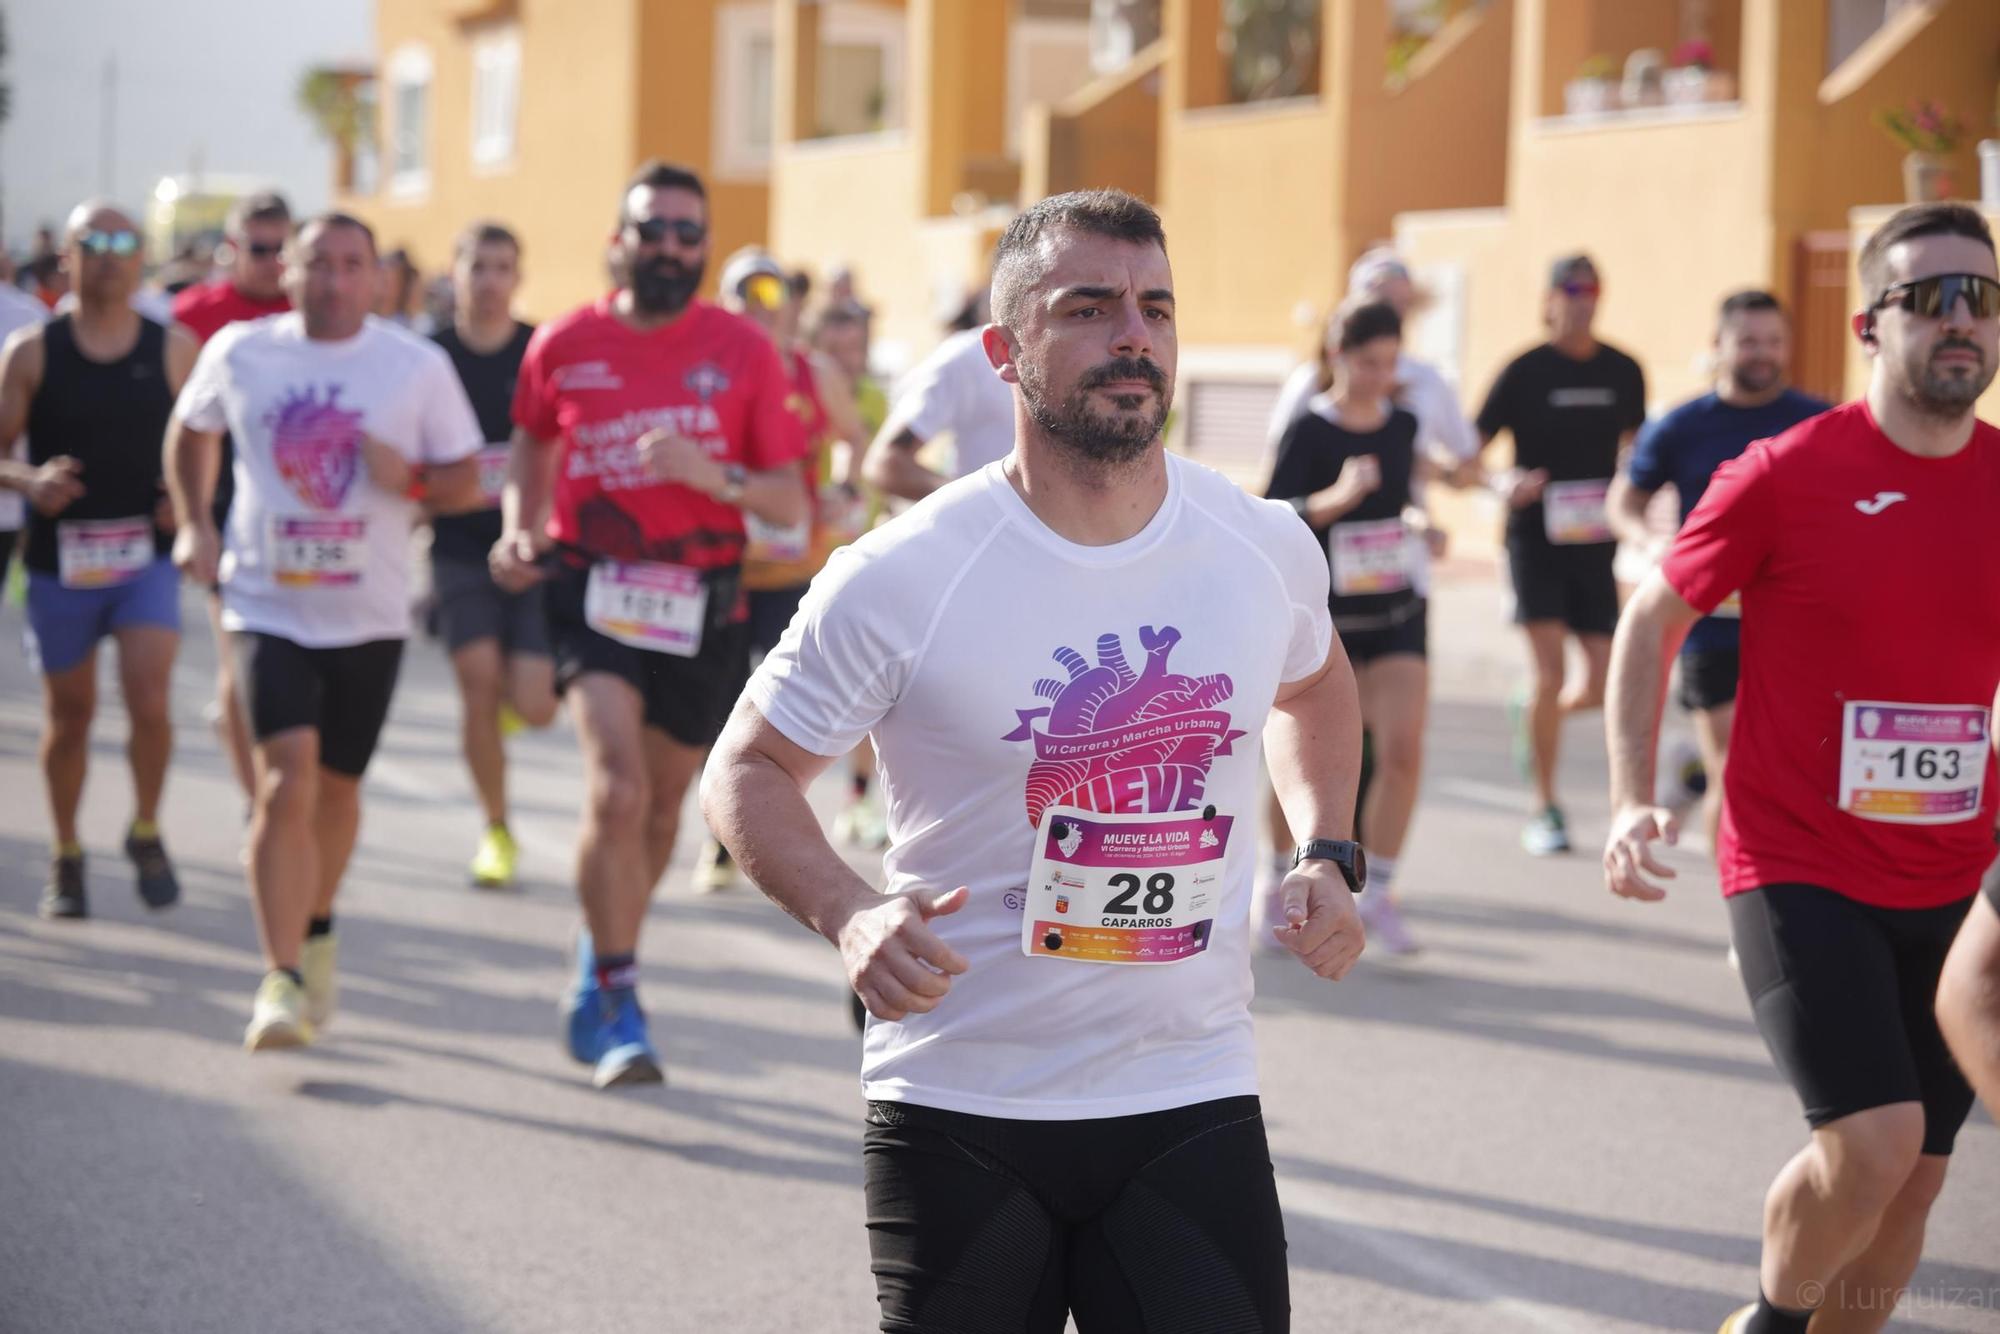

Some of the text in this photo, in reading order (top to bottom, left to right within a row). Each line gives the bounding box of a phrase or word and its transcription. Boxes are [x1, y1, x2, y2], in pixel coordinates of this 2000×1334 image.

[1045, 718, 1222, 755] VI Carrera y Marcha Urbana
[1888, 747, 1961, 780] 163
[1104, 831, 1190, 845] MUEVE LA VIDA
[1103, 872, 1176, 916] 28
[1101, 917, 1173, 929] CAPARROS
